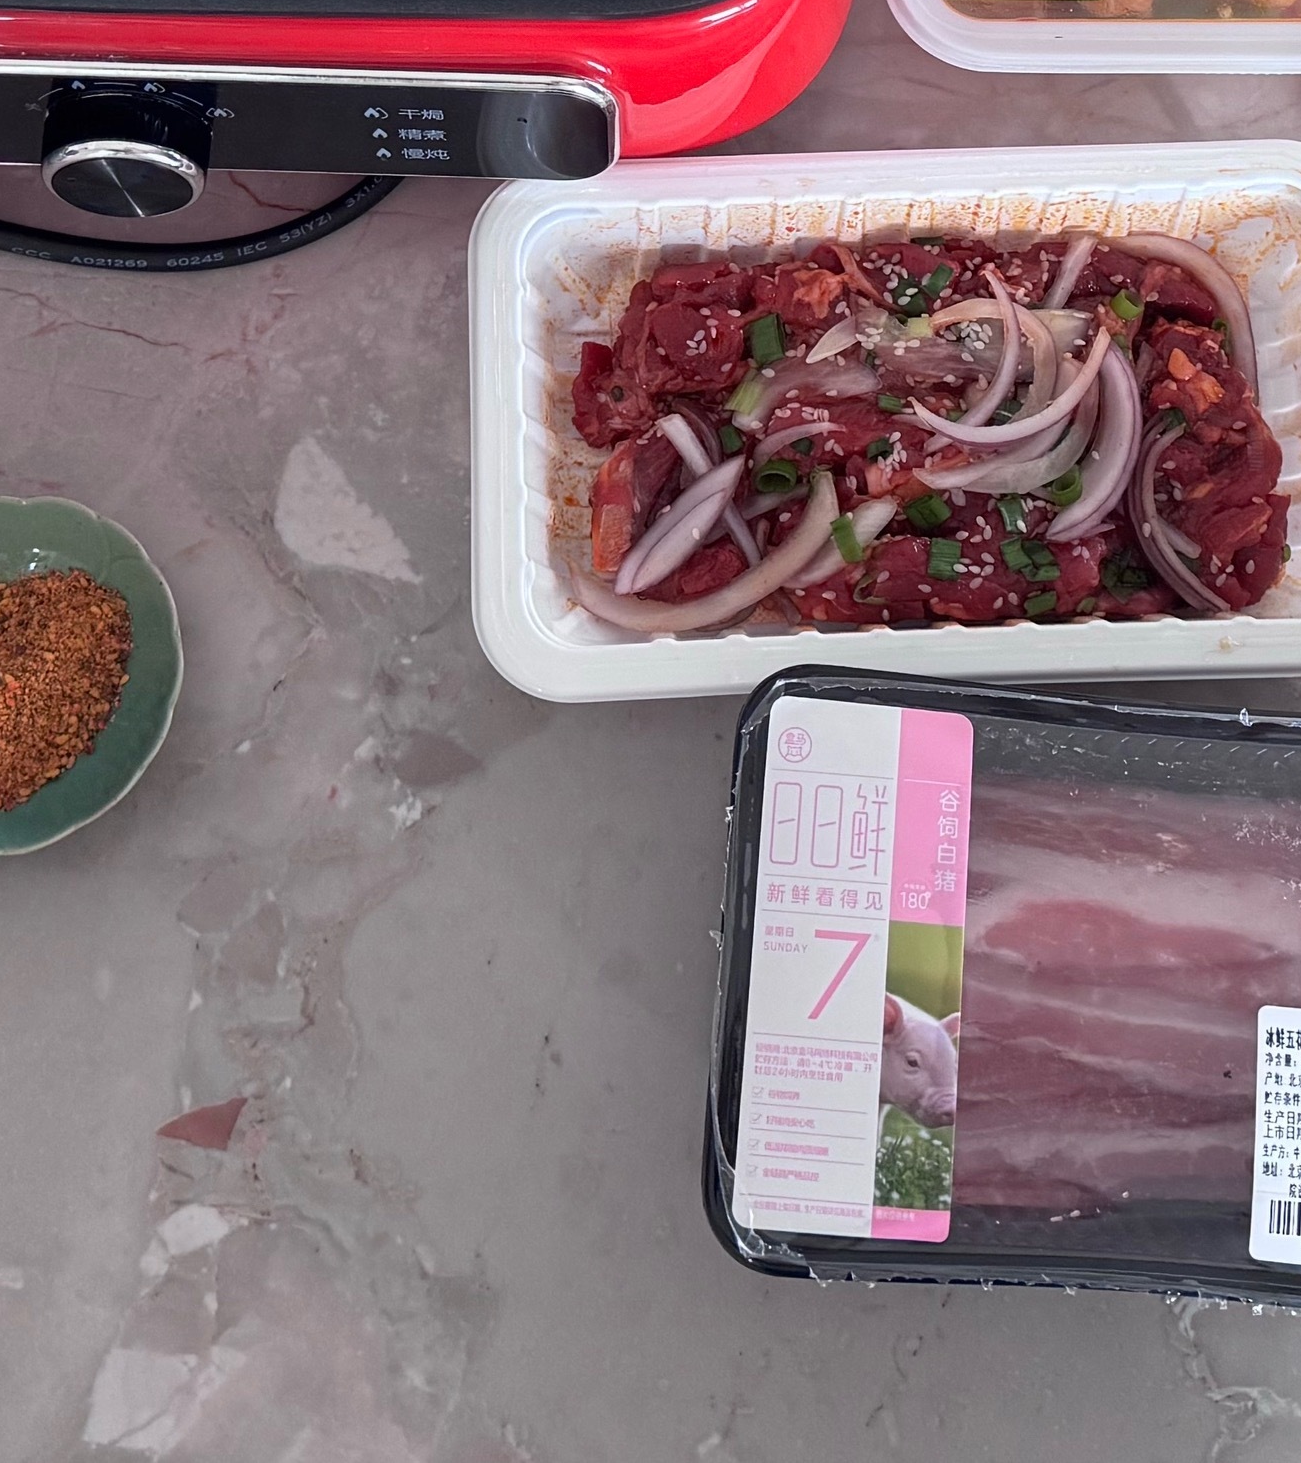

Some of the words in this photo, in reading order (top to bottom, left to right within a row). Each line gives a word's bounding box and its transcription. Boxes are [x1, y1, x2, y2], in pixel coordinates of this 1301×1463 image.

[398, 129, 447, 142] 精煮
[402, 147, 450, 161] 慢炖
[166, 251, 224, 268] 60245
[237, 240, 268, 256] IEC
[279, 212, 333, 242] 53(YZ)
[933, 789, 962, 893] 谷饲白猪
[766, 882, 884, 912] 新鲜看得见
[763, 940, 809, 954] SUNDAY
[807, 928, 872, 1020] 7
